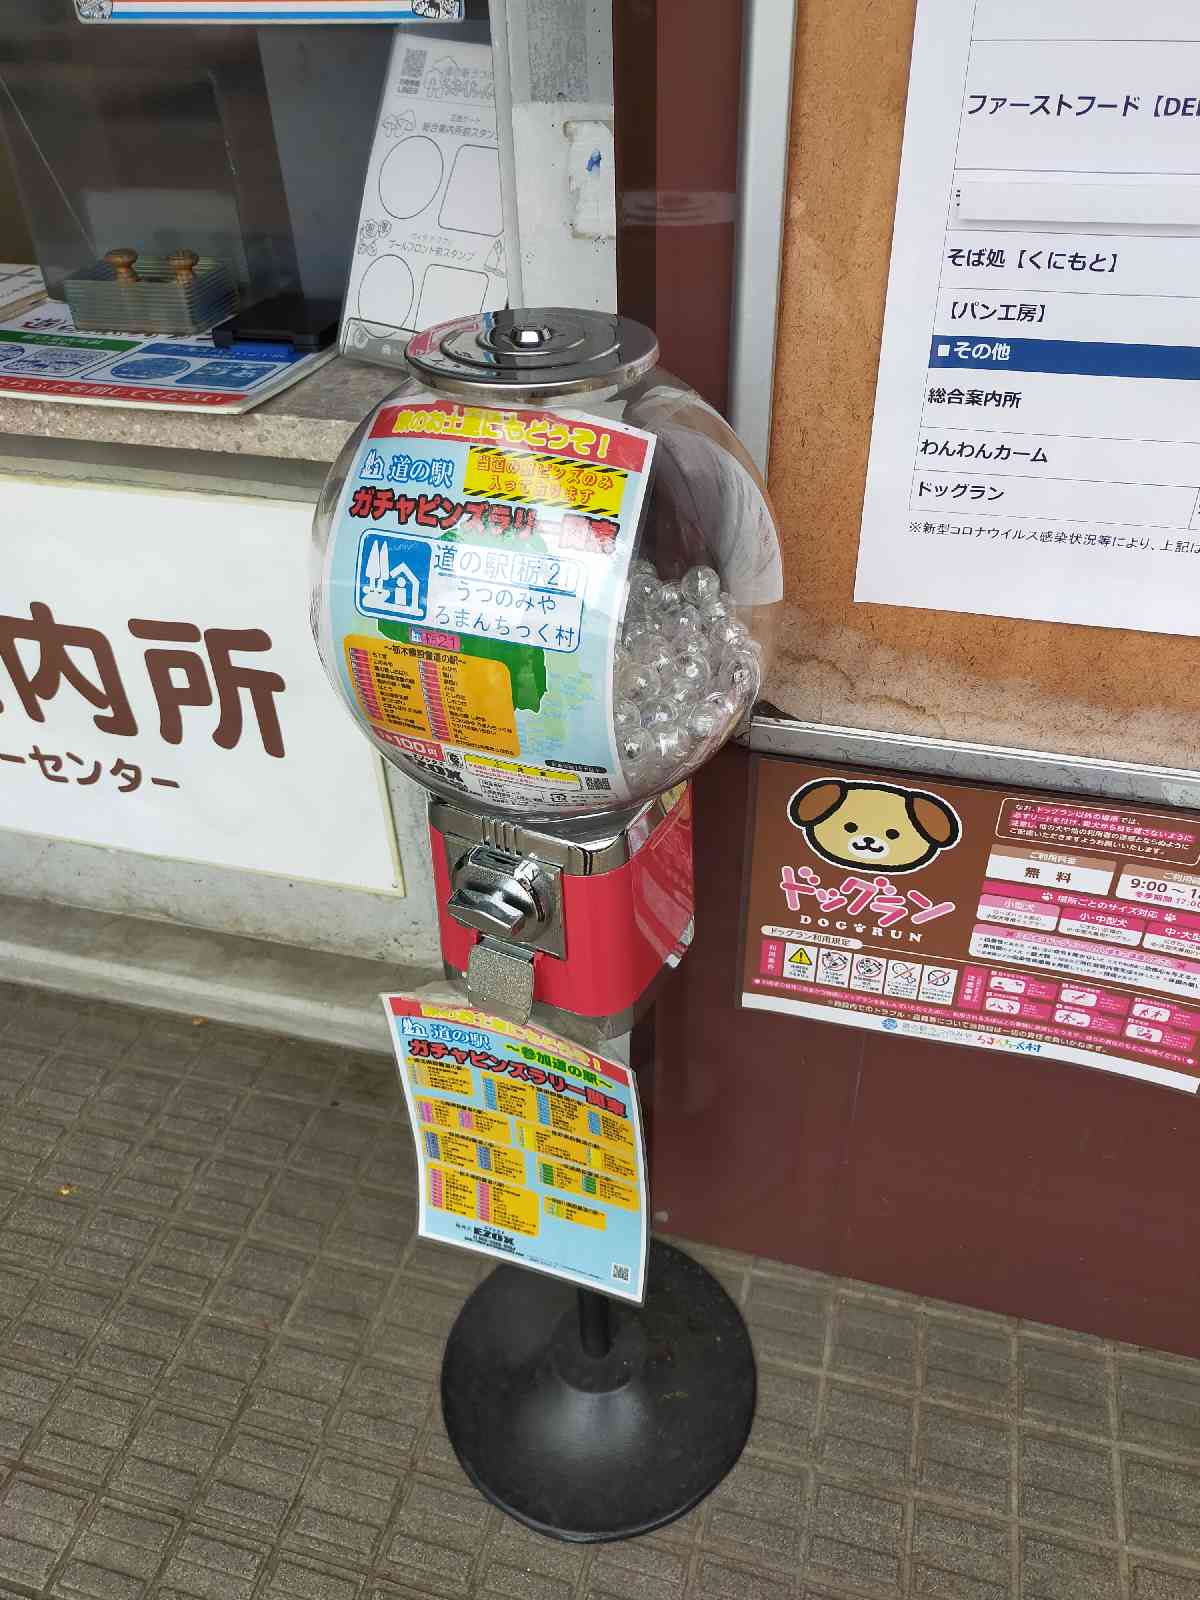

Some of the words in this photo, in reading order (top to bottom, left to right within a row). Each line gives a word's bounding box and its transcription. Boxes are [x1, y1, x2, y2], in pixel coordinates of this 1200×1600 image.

[968, 94, 1200, 117] ファーストフード【DE
[947, 249, 1118, 272] そば処【くにもと】
[950, 301, 1047, 323] 【パン工房】
[953, 341, 1011, 361] その他
[927, 387, 1022, 409] 総合案内所
[920, 439, 1049, 463] わんわんカーム
[388, 453, 453, 487] 道の駅
[918, 482, 1005, 500] ドッグラン
[434, 546, 509, 580] 道の駅
[456, 580, 556, 614] うつのみや
[435, 605, 575, 648] ろまんちっく村
[780, 866, 956, 927] ドッグラン
[799, 915, 847, 930] DOG
[871, 927, 923, 943] RUN
